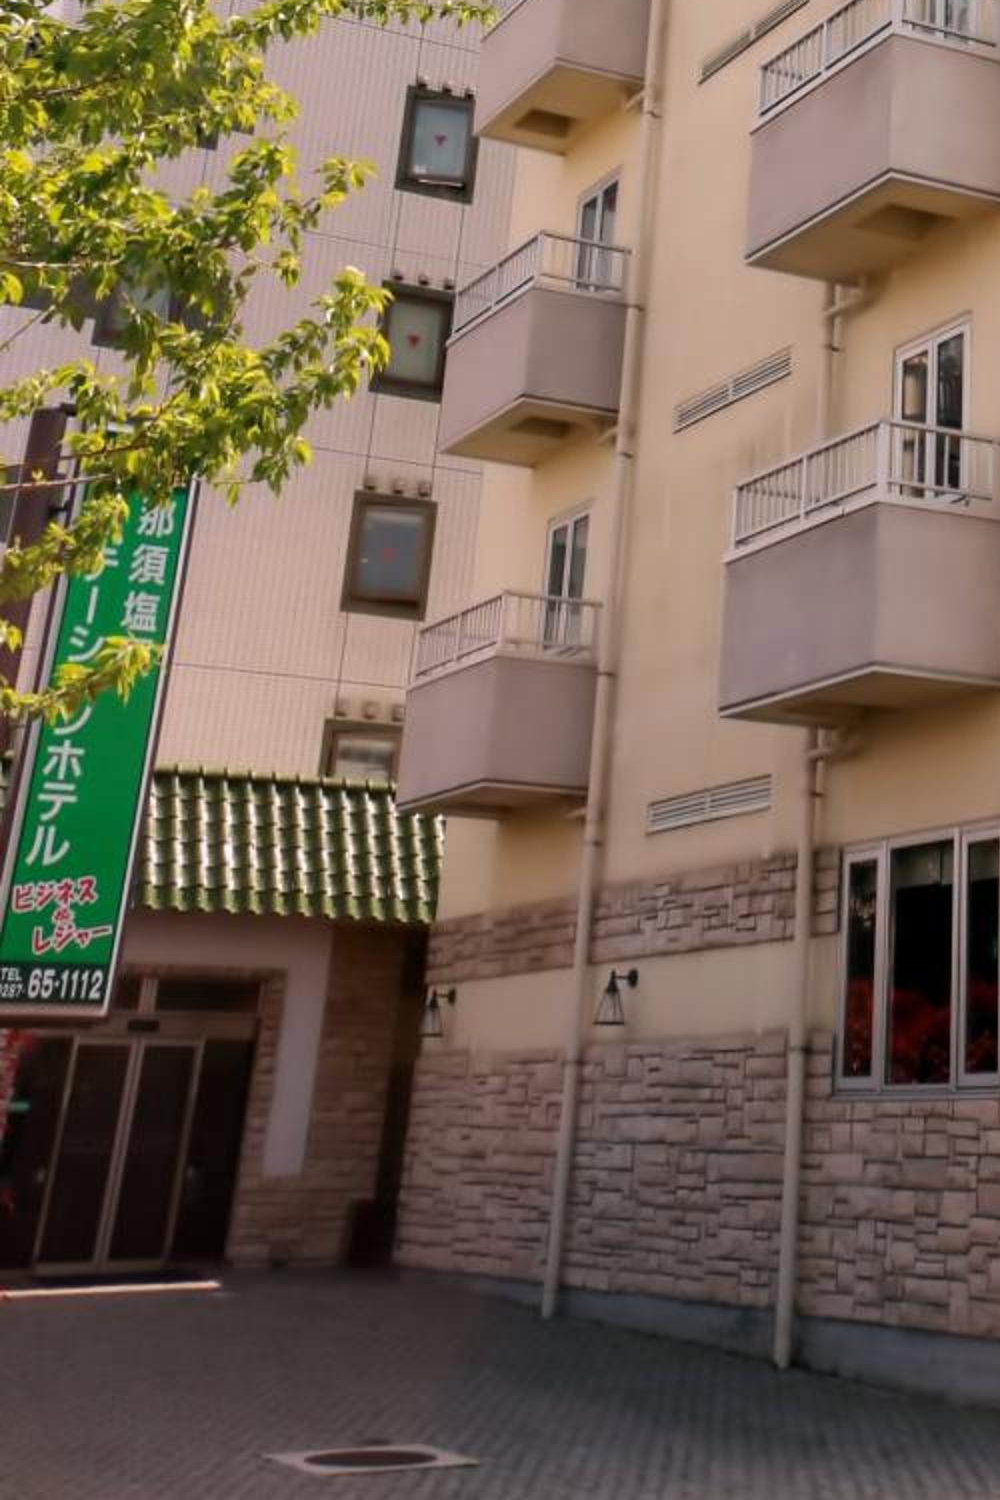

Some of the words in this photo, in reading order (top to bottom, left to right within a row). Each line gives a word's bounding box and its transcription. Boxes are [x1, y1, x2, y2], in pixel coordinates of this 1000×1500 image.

[118, 497, 177, 658] 那須塩
[12, 875, 98, 913] ビジネス
[32, 923, 113, 955] レジャー
